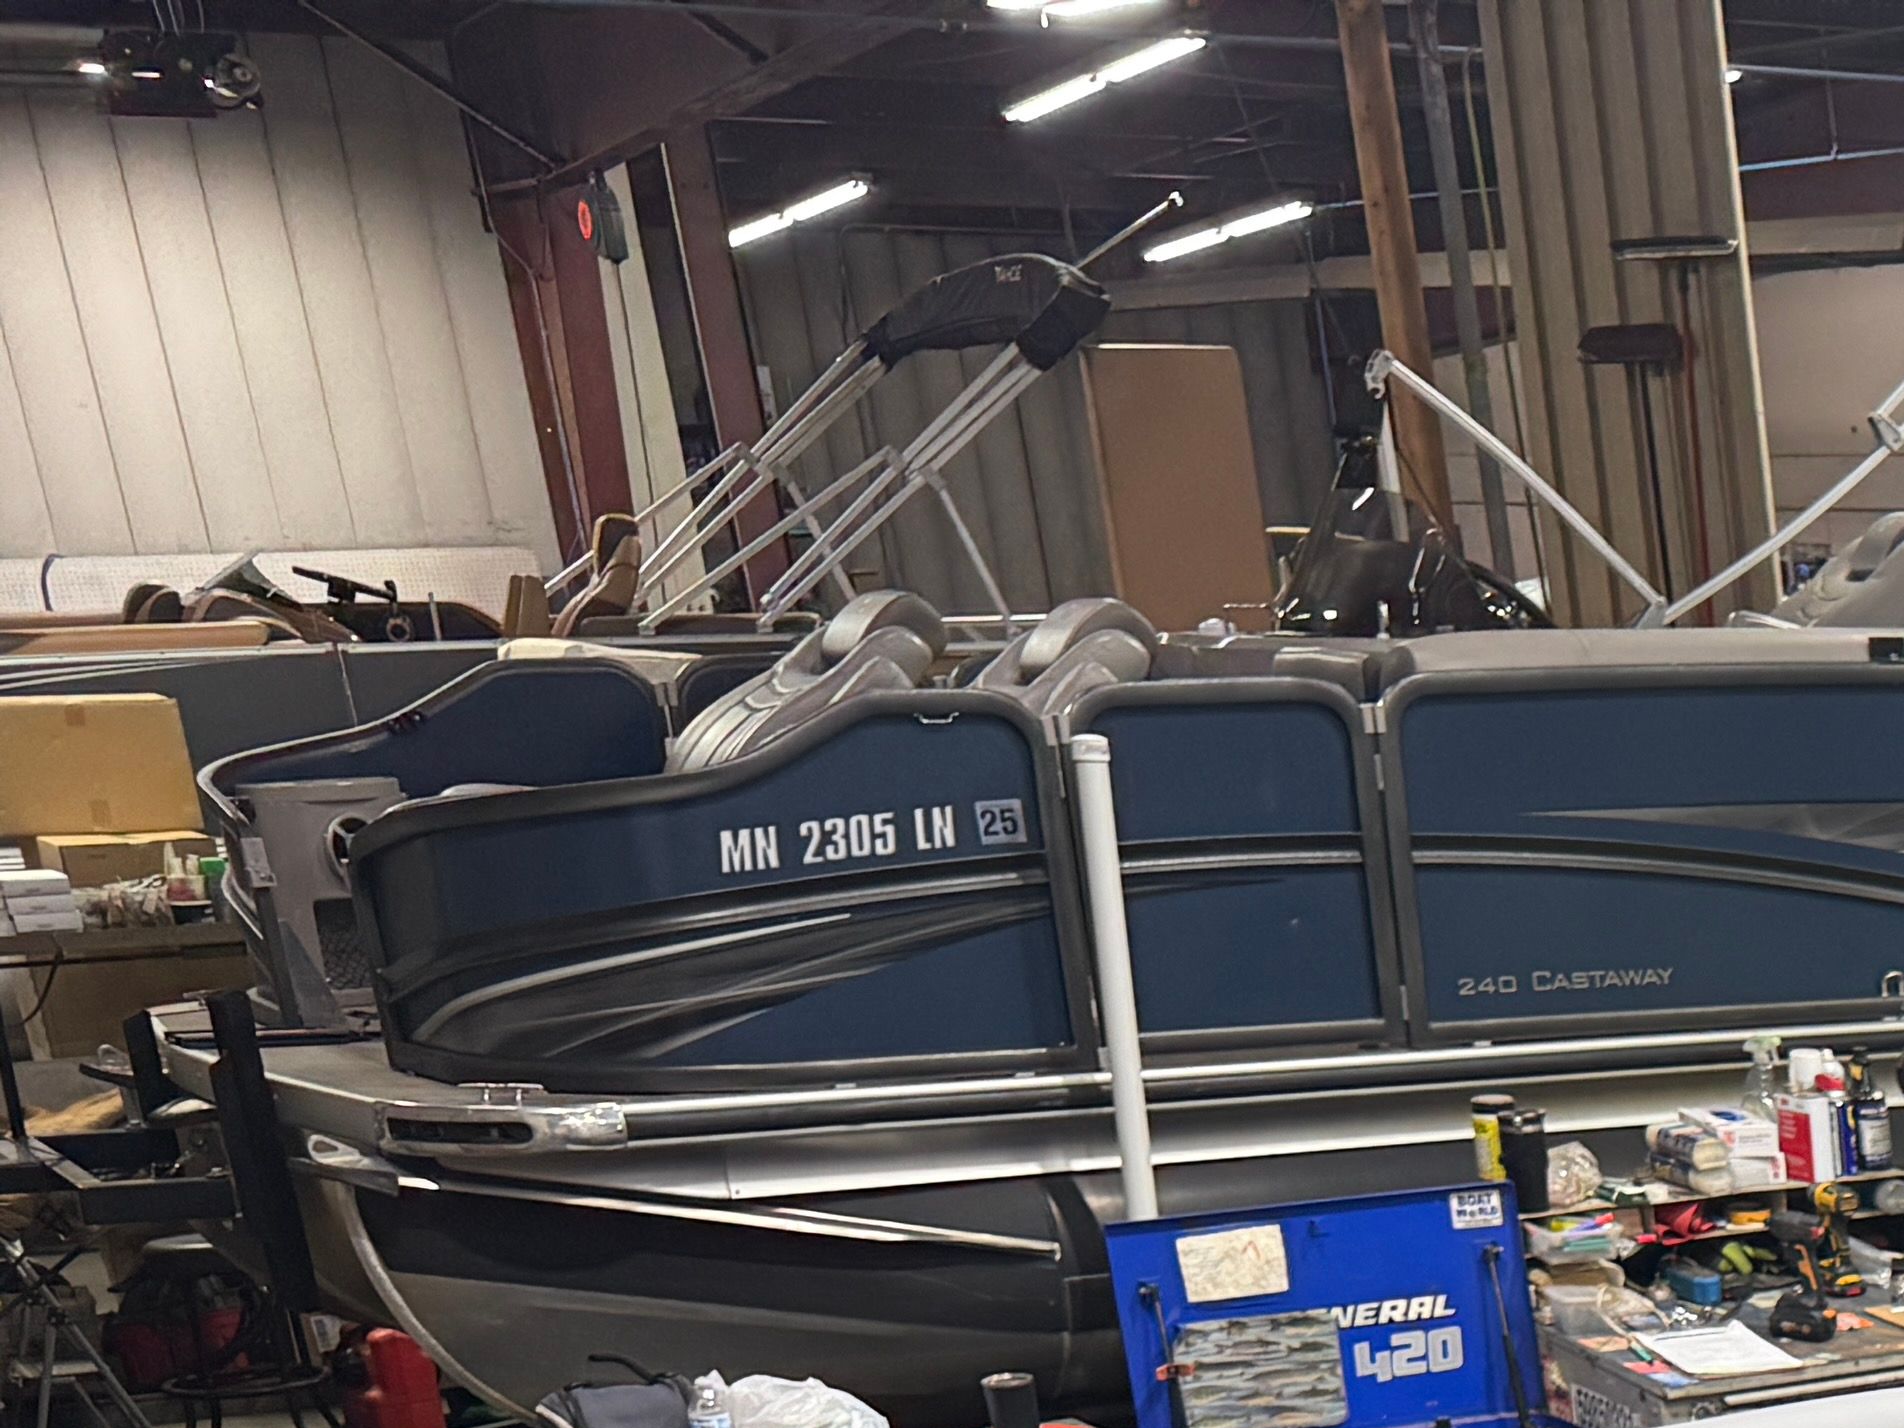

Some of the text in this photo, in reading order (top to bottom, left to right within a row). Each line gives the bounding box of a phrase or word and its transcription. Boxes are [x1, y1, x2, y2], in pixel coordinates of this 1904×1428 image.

[720, 805, 1018, 873] MN 2305 LN 25
[1457, 975, 1518, 996] 240
[1327, 1294, 1456, 1328] NERAL
[1353, 1325, 1465, 1383] 420
